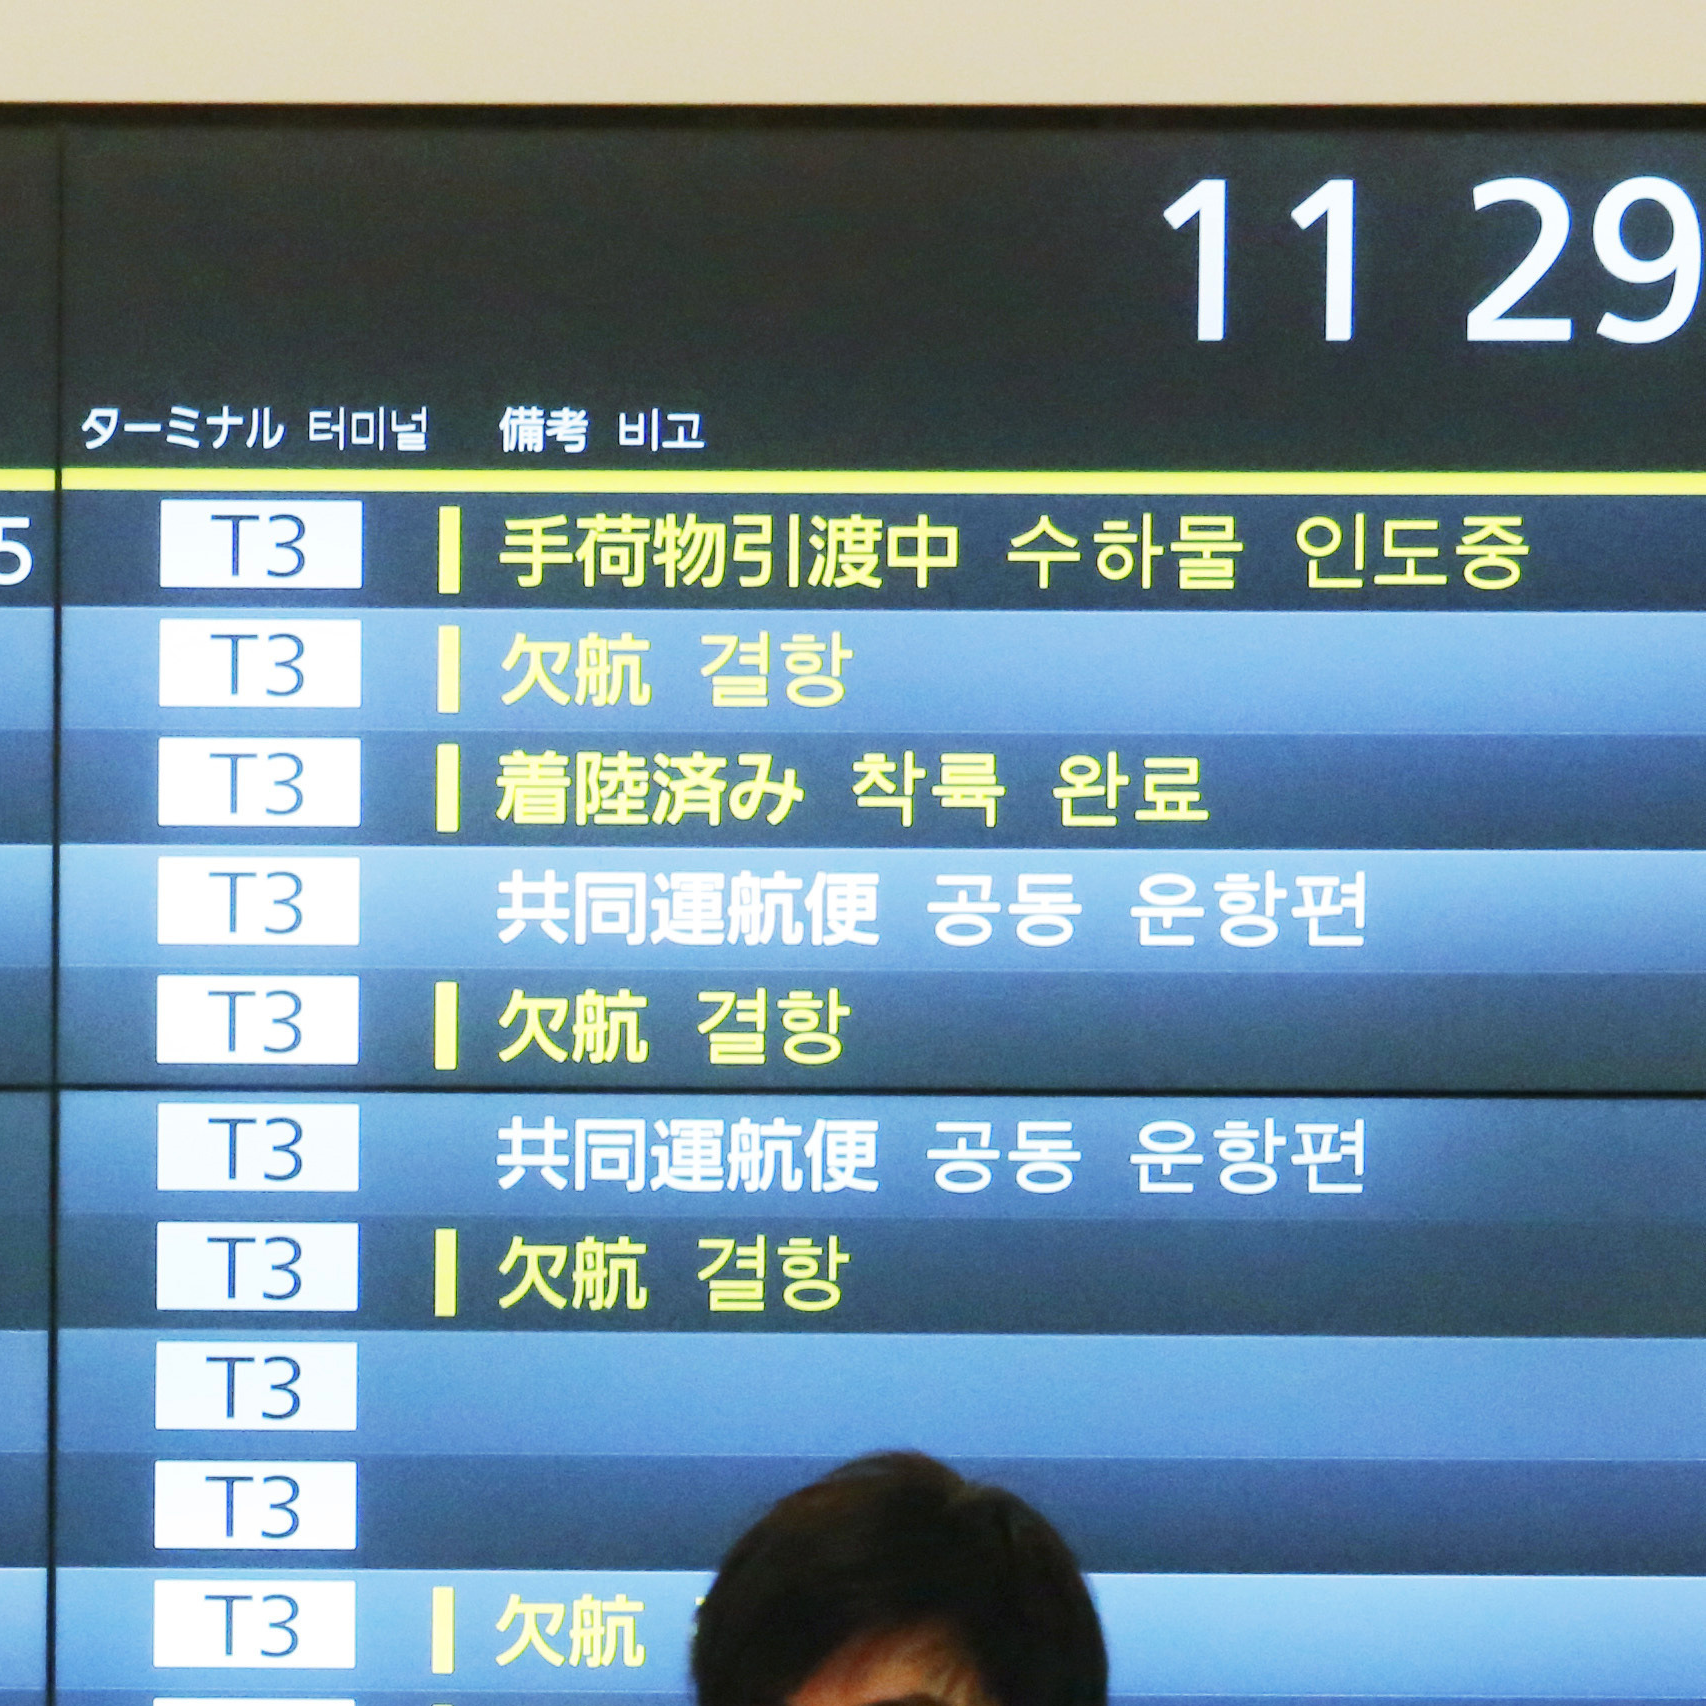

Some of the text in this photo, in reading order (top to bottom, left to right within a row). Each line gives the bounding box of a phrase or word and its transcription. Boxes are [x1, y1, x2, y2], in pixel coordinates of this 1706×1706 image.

[1163, 177, 1701, 343] 11 29
[82, 406, 427, 451] ターミナル 터미널
[499, 406, 704, 453] 備考 비고
[210, 513, 306, 578] T3
[499, 513, 1529, 590] 手荷物引渡中 수하물 인도중
[501, 630, 853, 708] 欠航 결항
[496, 750, 1209, 827] 着陸済み 착륙 완료
[496, 868, 1366, 947] 共同運航便 공동 운항편
[499, 1235, 850, 1311] 欠航 결항
[204, 1594, 299, 1658] T3
